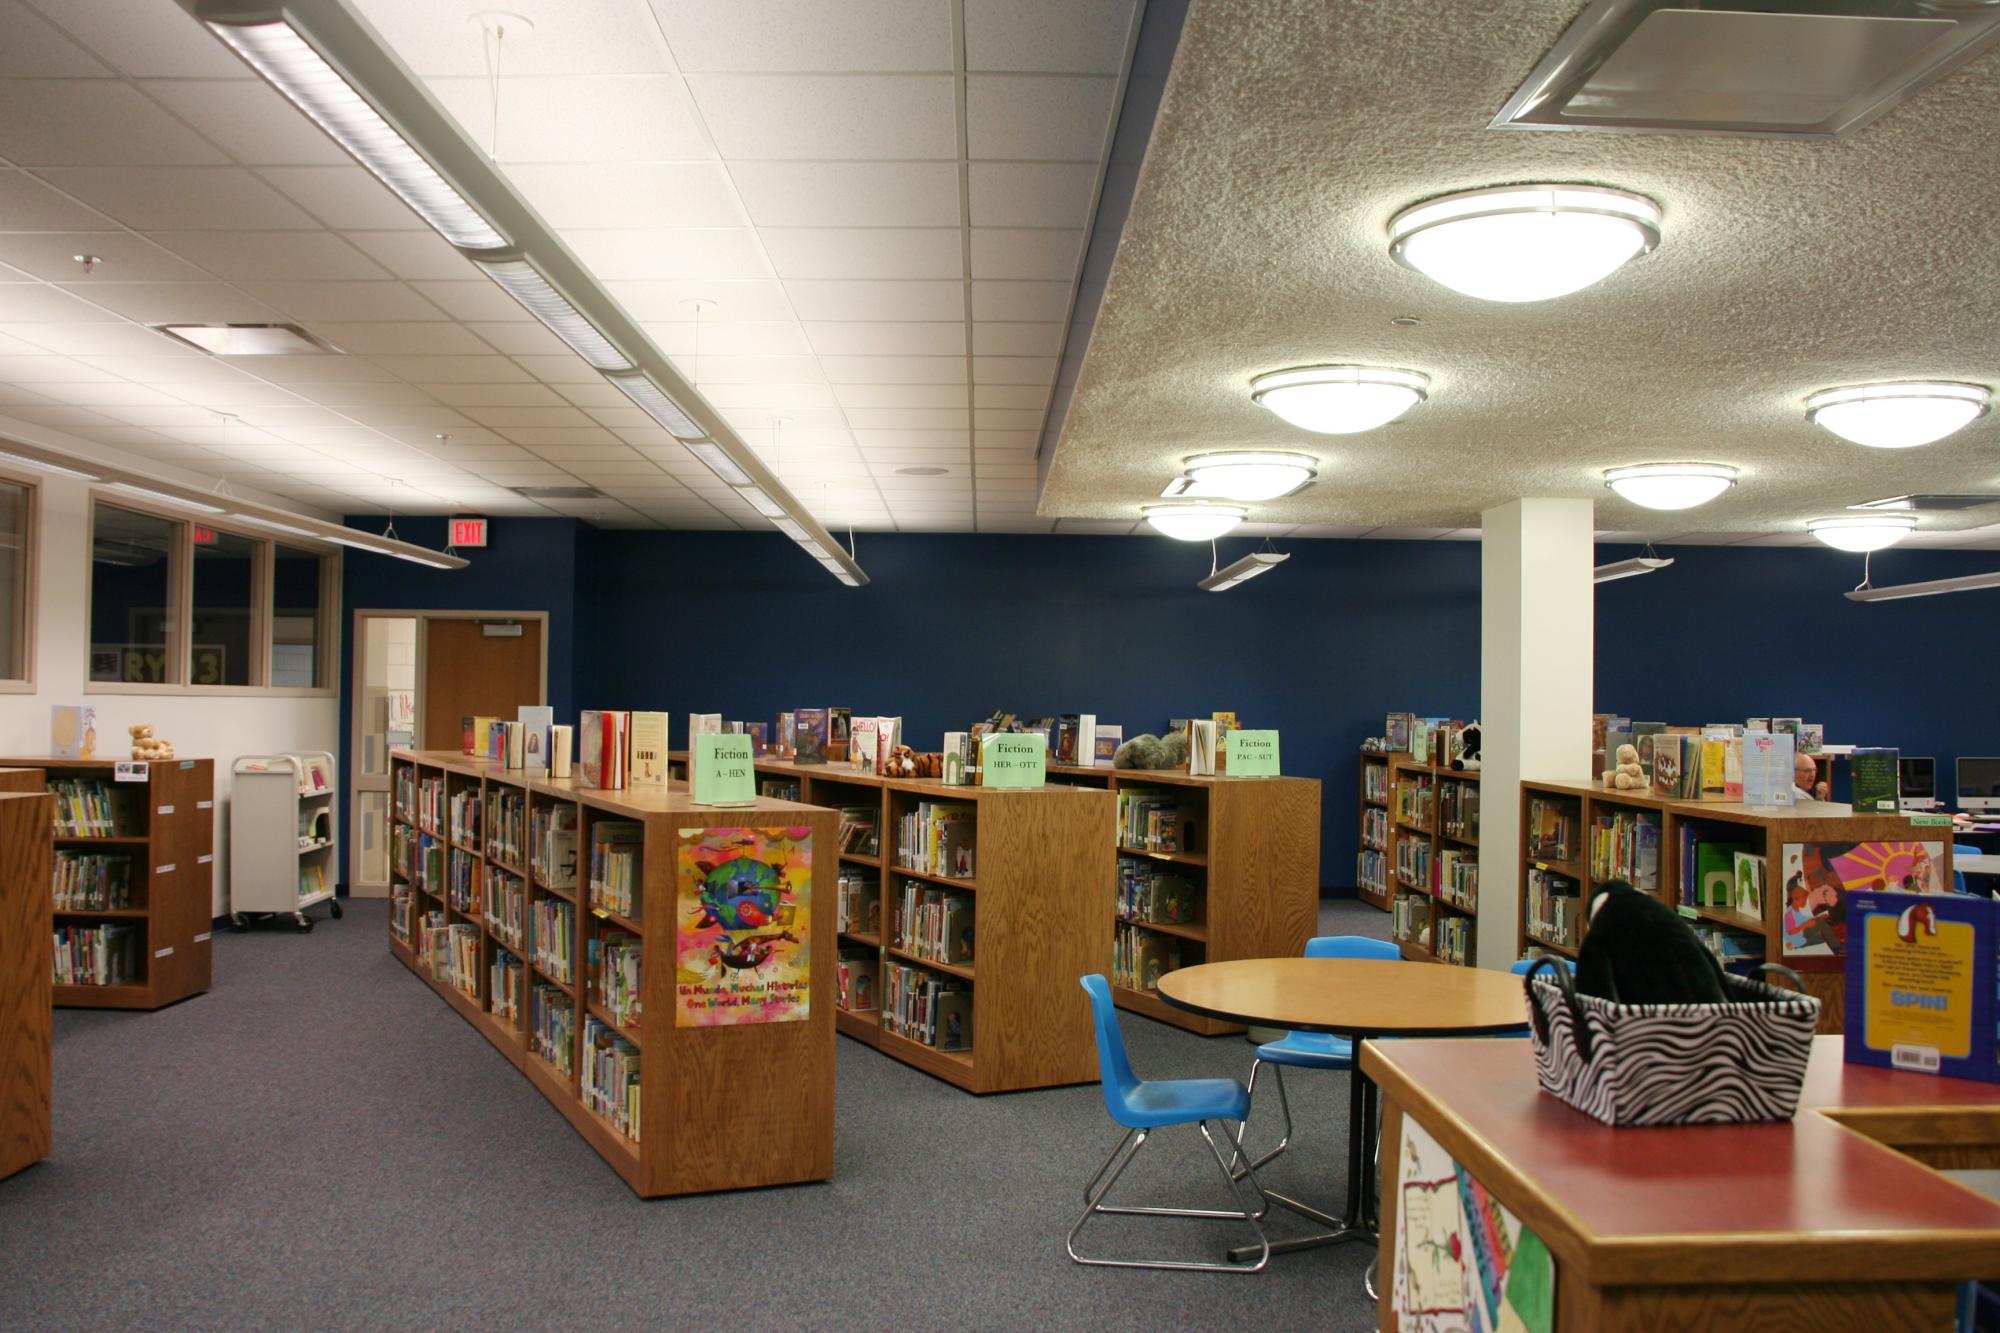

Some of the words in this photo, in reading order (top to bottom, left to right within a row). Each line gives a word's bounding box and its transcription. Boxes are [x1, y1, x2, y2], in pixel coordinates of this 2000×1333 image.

[454, 521, 483, 545] EXIT
[997, 743, 1034, 753] Fiction
[1240, 739, 1271, 747] Fiction
[714, 747, 748, 760] Fiction
[1019, 761, 1038, 769] OTT
[716, 769, 722, 778] A
[729, 769, 746, 778] HEN
[679, 985, 692, 995] Un
[731, 983, 765, 993] Muchas
[686, 998, 707, 1009] One
[741, 995, 767, 1007] Many
[769, 993, 800, 1004] Stories
